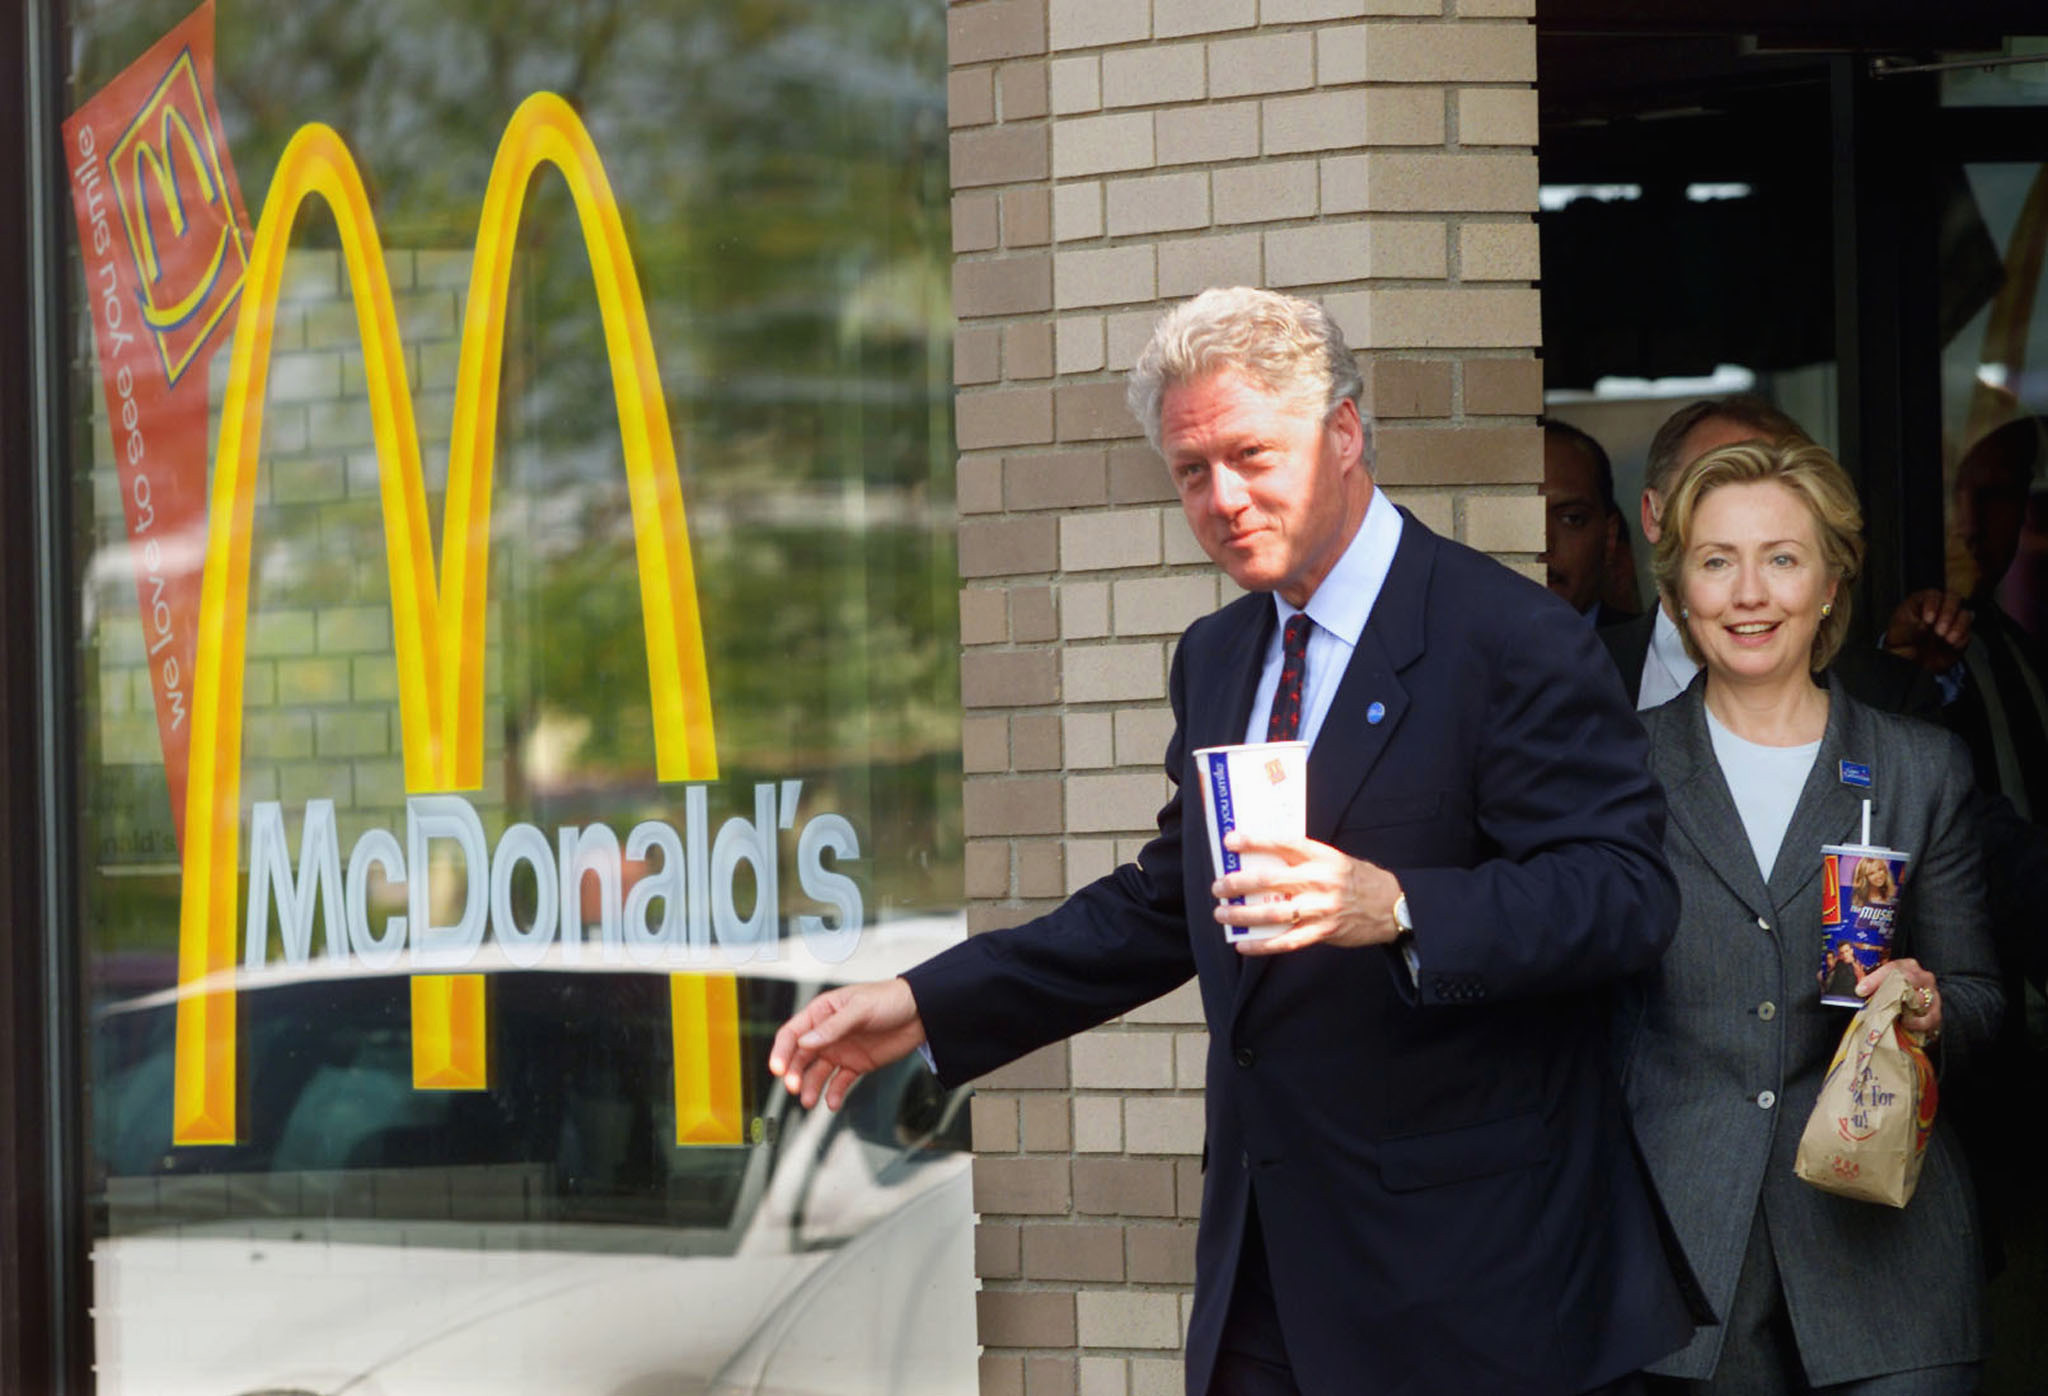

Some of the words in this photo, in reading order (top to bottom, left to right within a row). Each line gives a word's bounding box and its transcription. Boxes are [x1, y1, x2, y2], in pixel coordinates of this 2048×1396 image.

[75, 125, 111, 256] smile
[99, 261, 134, 358] you
[118, 365, 144, 465] see
[134, 473, 154, 533] to
[144, 538, 174, 655] love
[163, 655, 186, 731] we
[1213, 762, 1229, 798] smile
[1220, 799, 1235, 825] you
[245, 780, 865, 970] McDonald's
